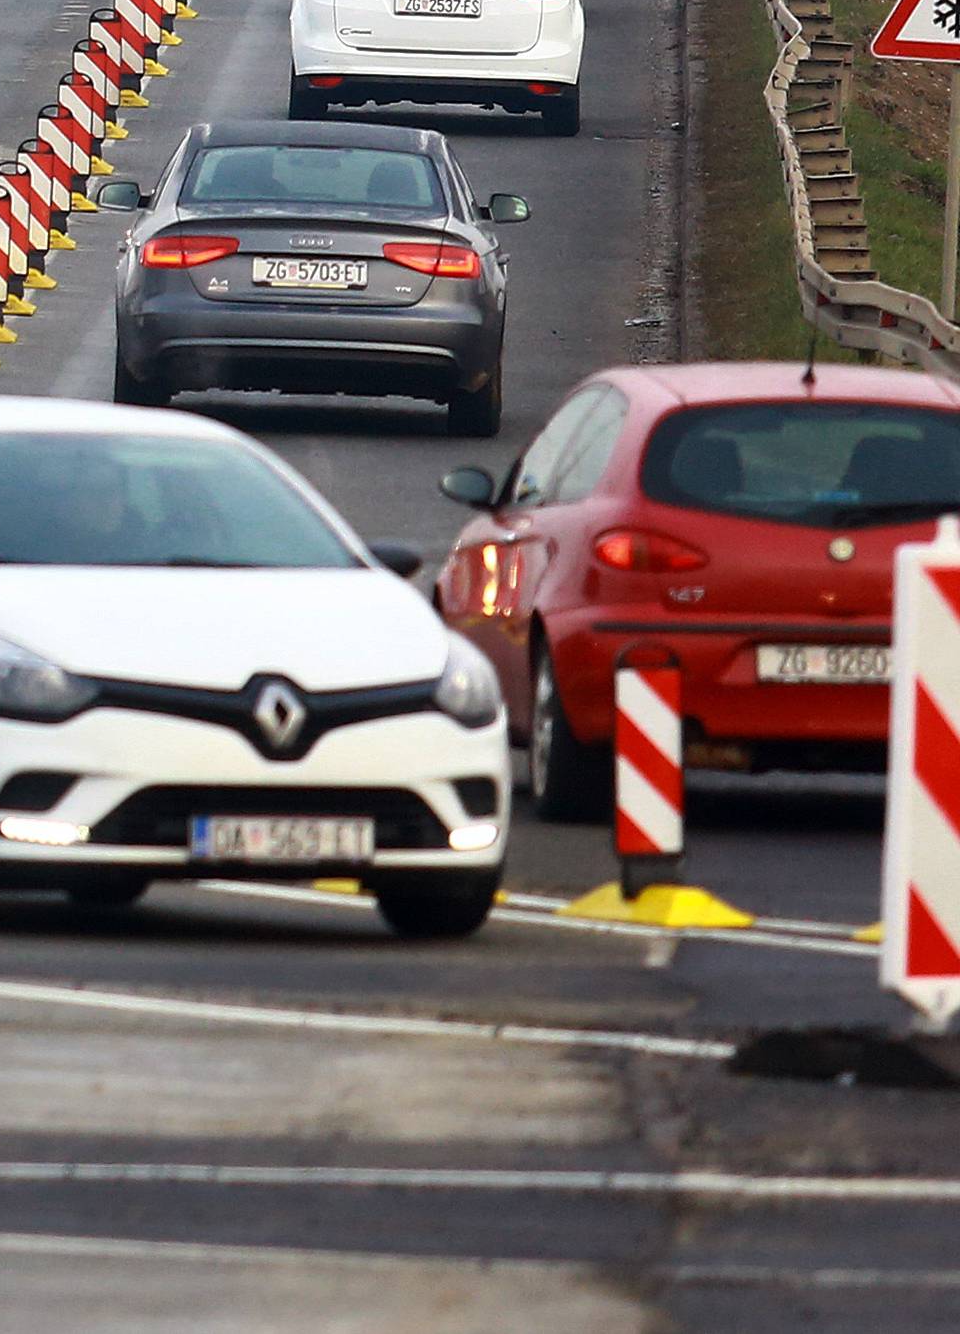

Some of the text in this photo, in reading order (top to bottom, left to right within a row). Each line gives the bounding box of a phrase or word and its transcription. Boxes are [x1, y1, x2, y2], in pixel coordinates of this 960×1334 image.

[429, 0, 480, 14] 2537-FS
[266, 261, 365, 282] ZG 5703-ET
[778, 648, 888, 676] ZG 9260
